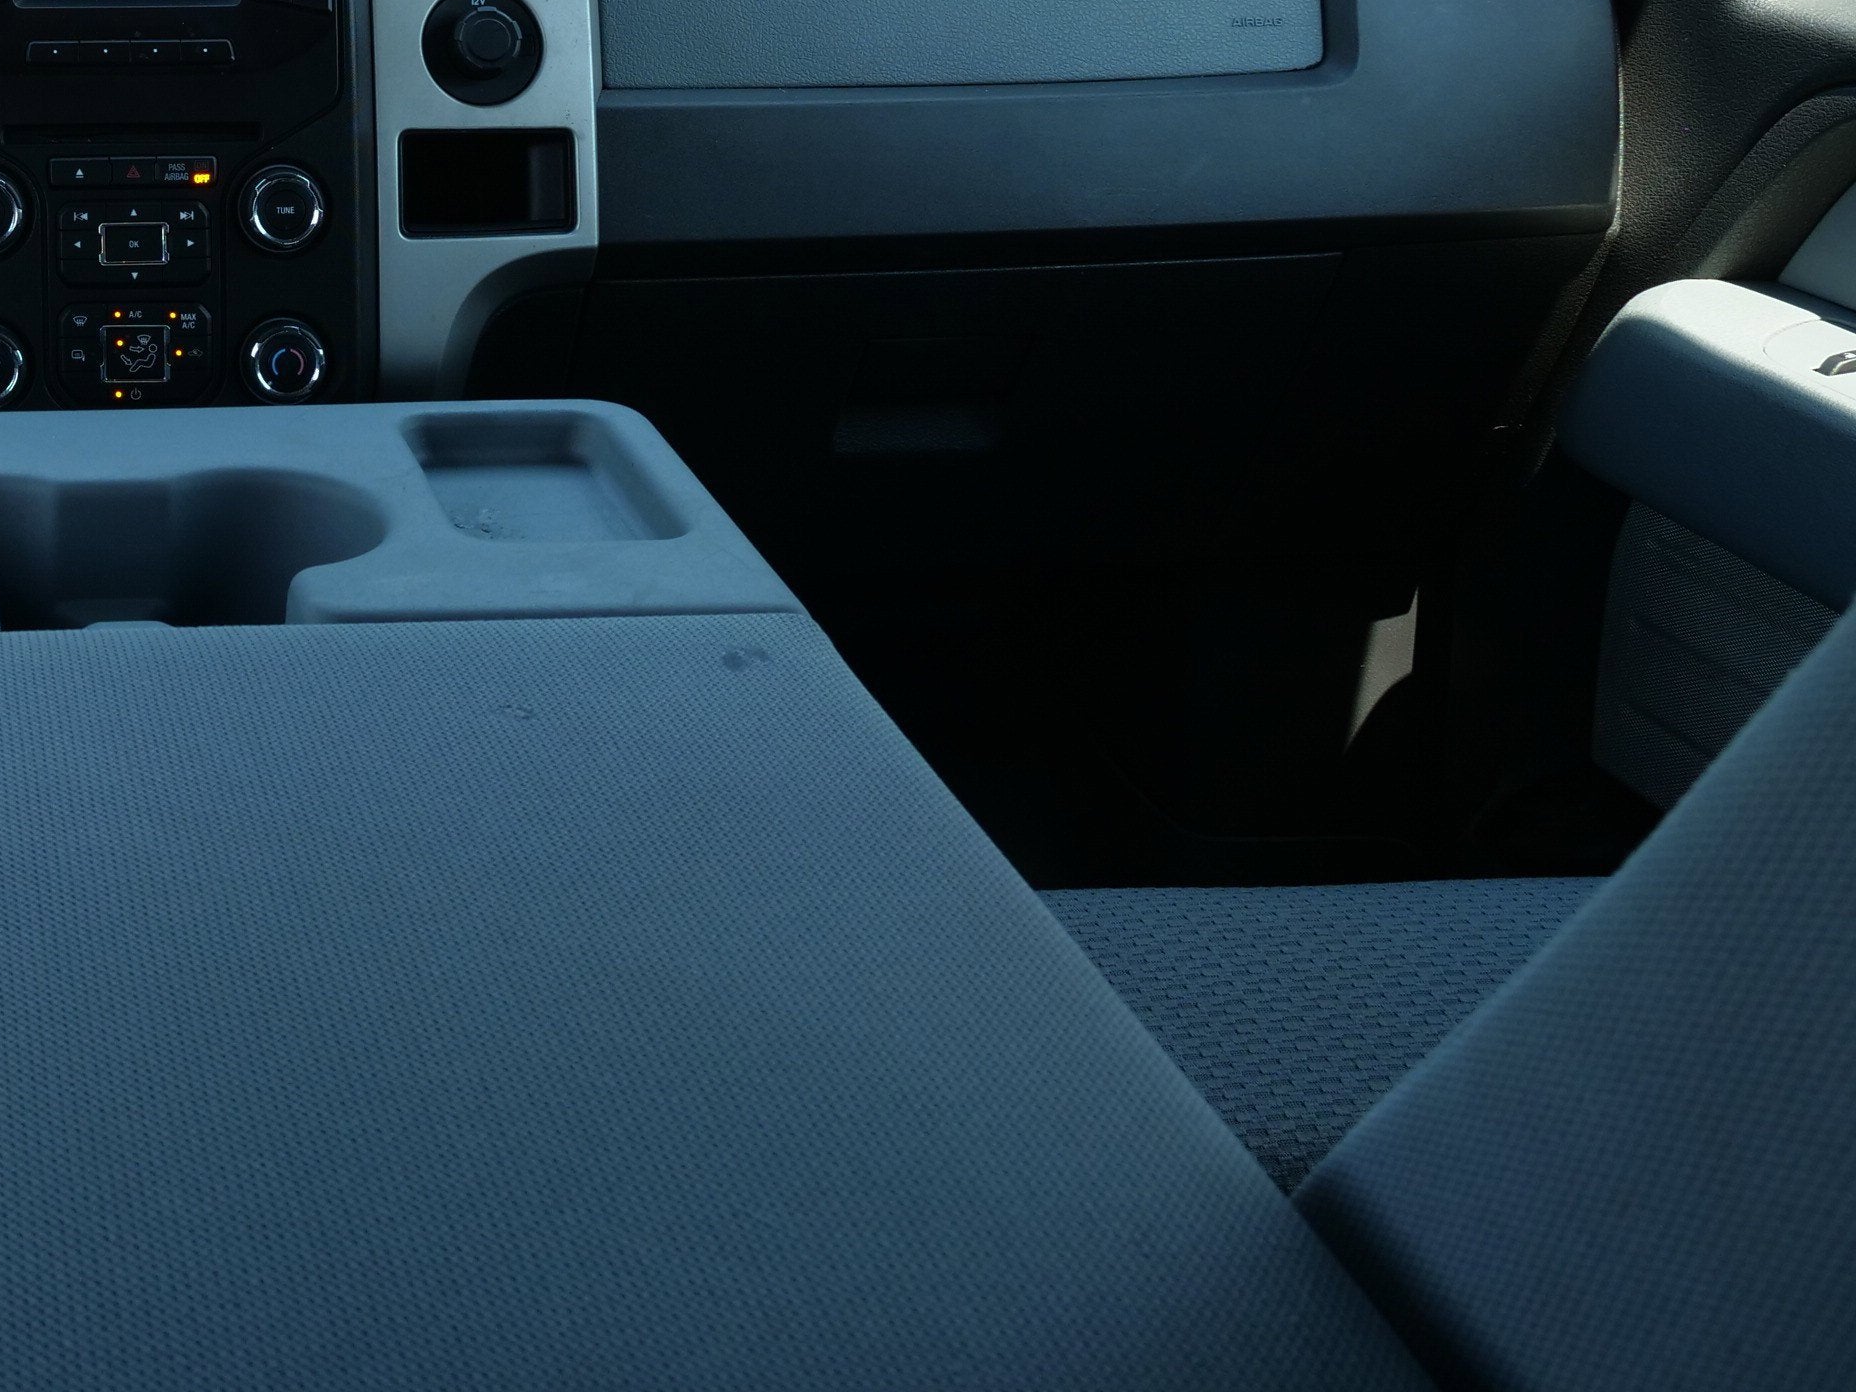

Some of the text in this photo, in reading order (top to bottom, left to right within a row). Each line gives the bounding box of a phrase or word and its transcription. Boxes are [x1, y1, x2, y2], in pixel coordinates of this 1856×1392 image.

[1231, 18, 1283, 28] AIRBAG
[168, 163, 186, 172] PASS
[164, 172, 210, 183] AIRBAG OFF
[128, 240, 140, 248] OK
[129, 310, 142, 319] A/C
[181, 313, 196, 321] MAX
[182, 321, 195, 329] A/C
